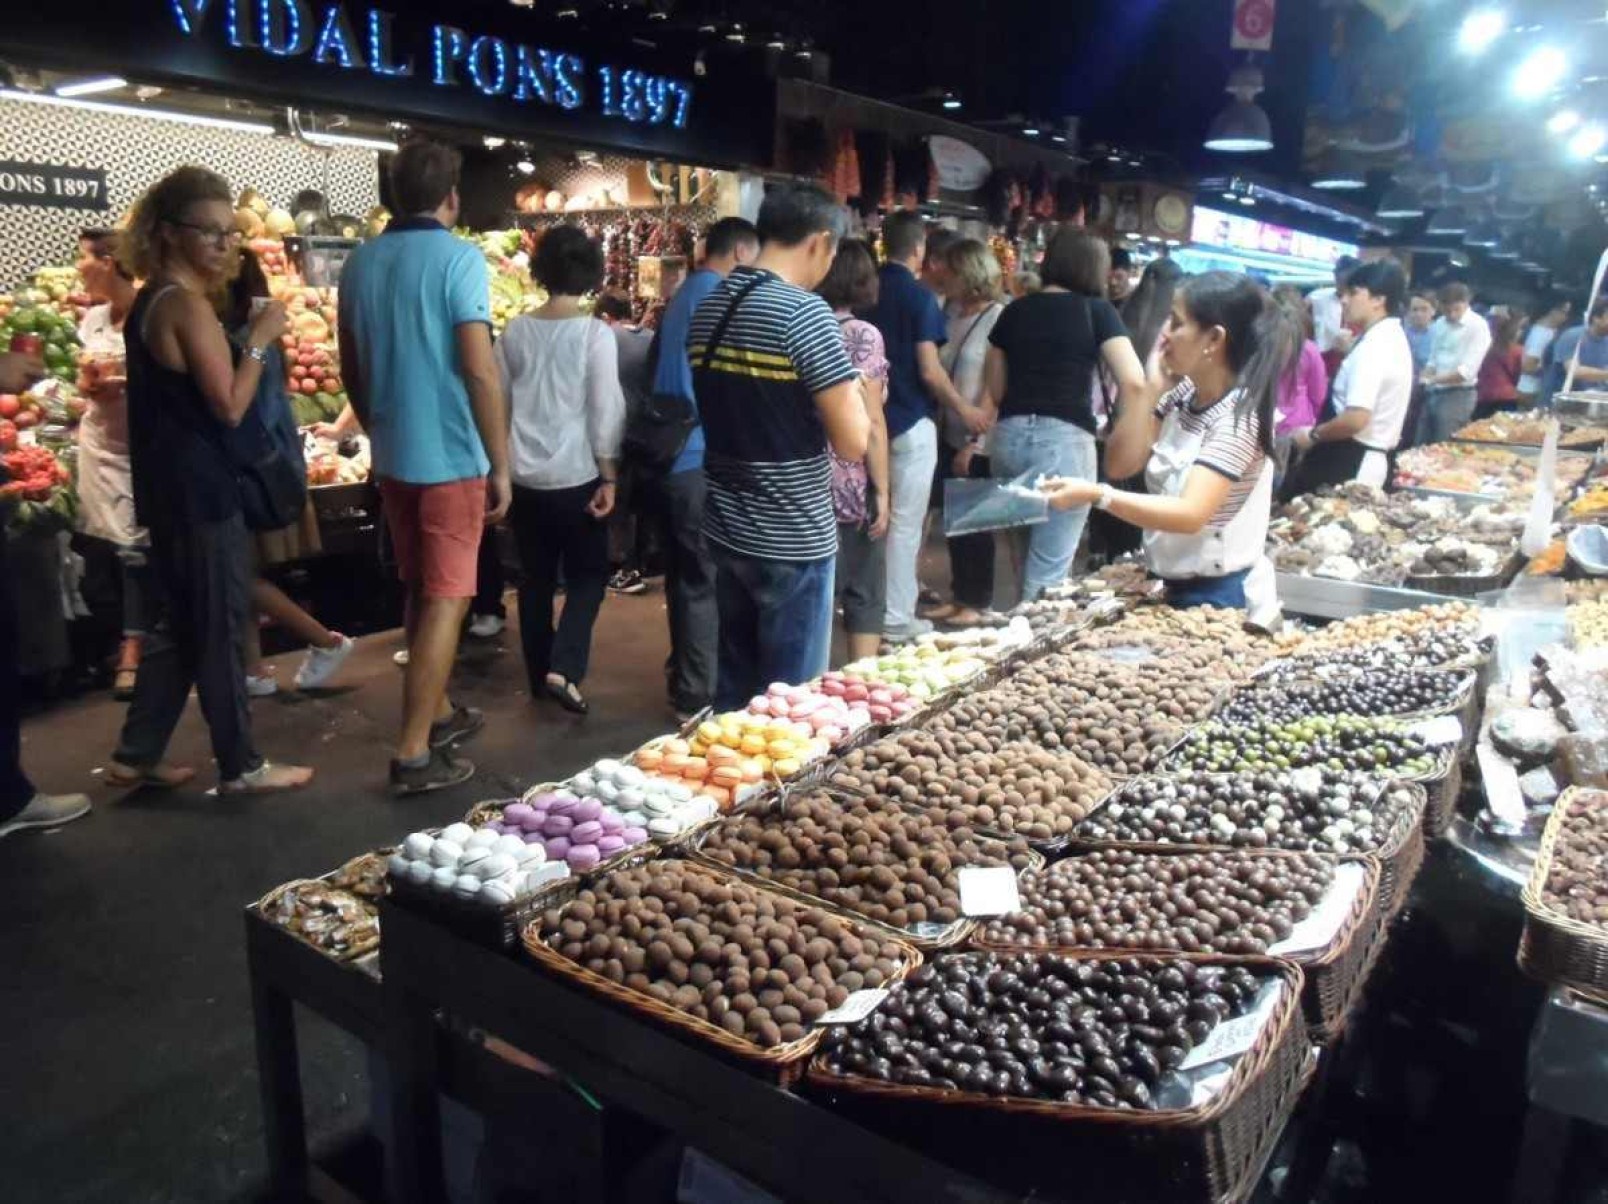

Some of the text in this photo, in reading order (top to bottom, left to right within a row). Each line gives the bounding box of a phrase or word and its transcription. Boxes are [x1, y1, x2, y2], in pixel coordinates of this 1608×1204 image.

[171, 0, 691, 129] VIDAL PONS 1897
[53, 177, 99, 198] 1897
